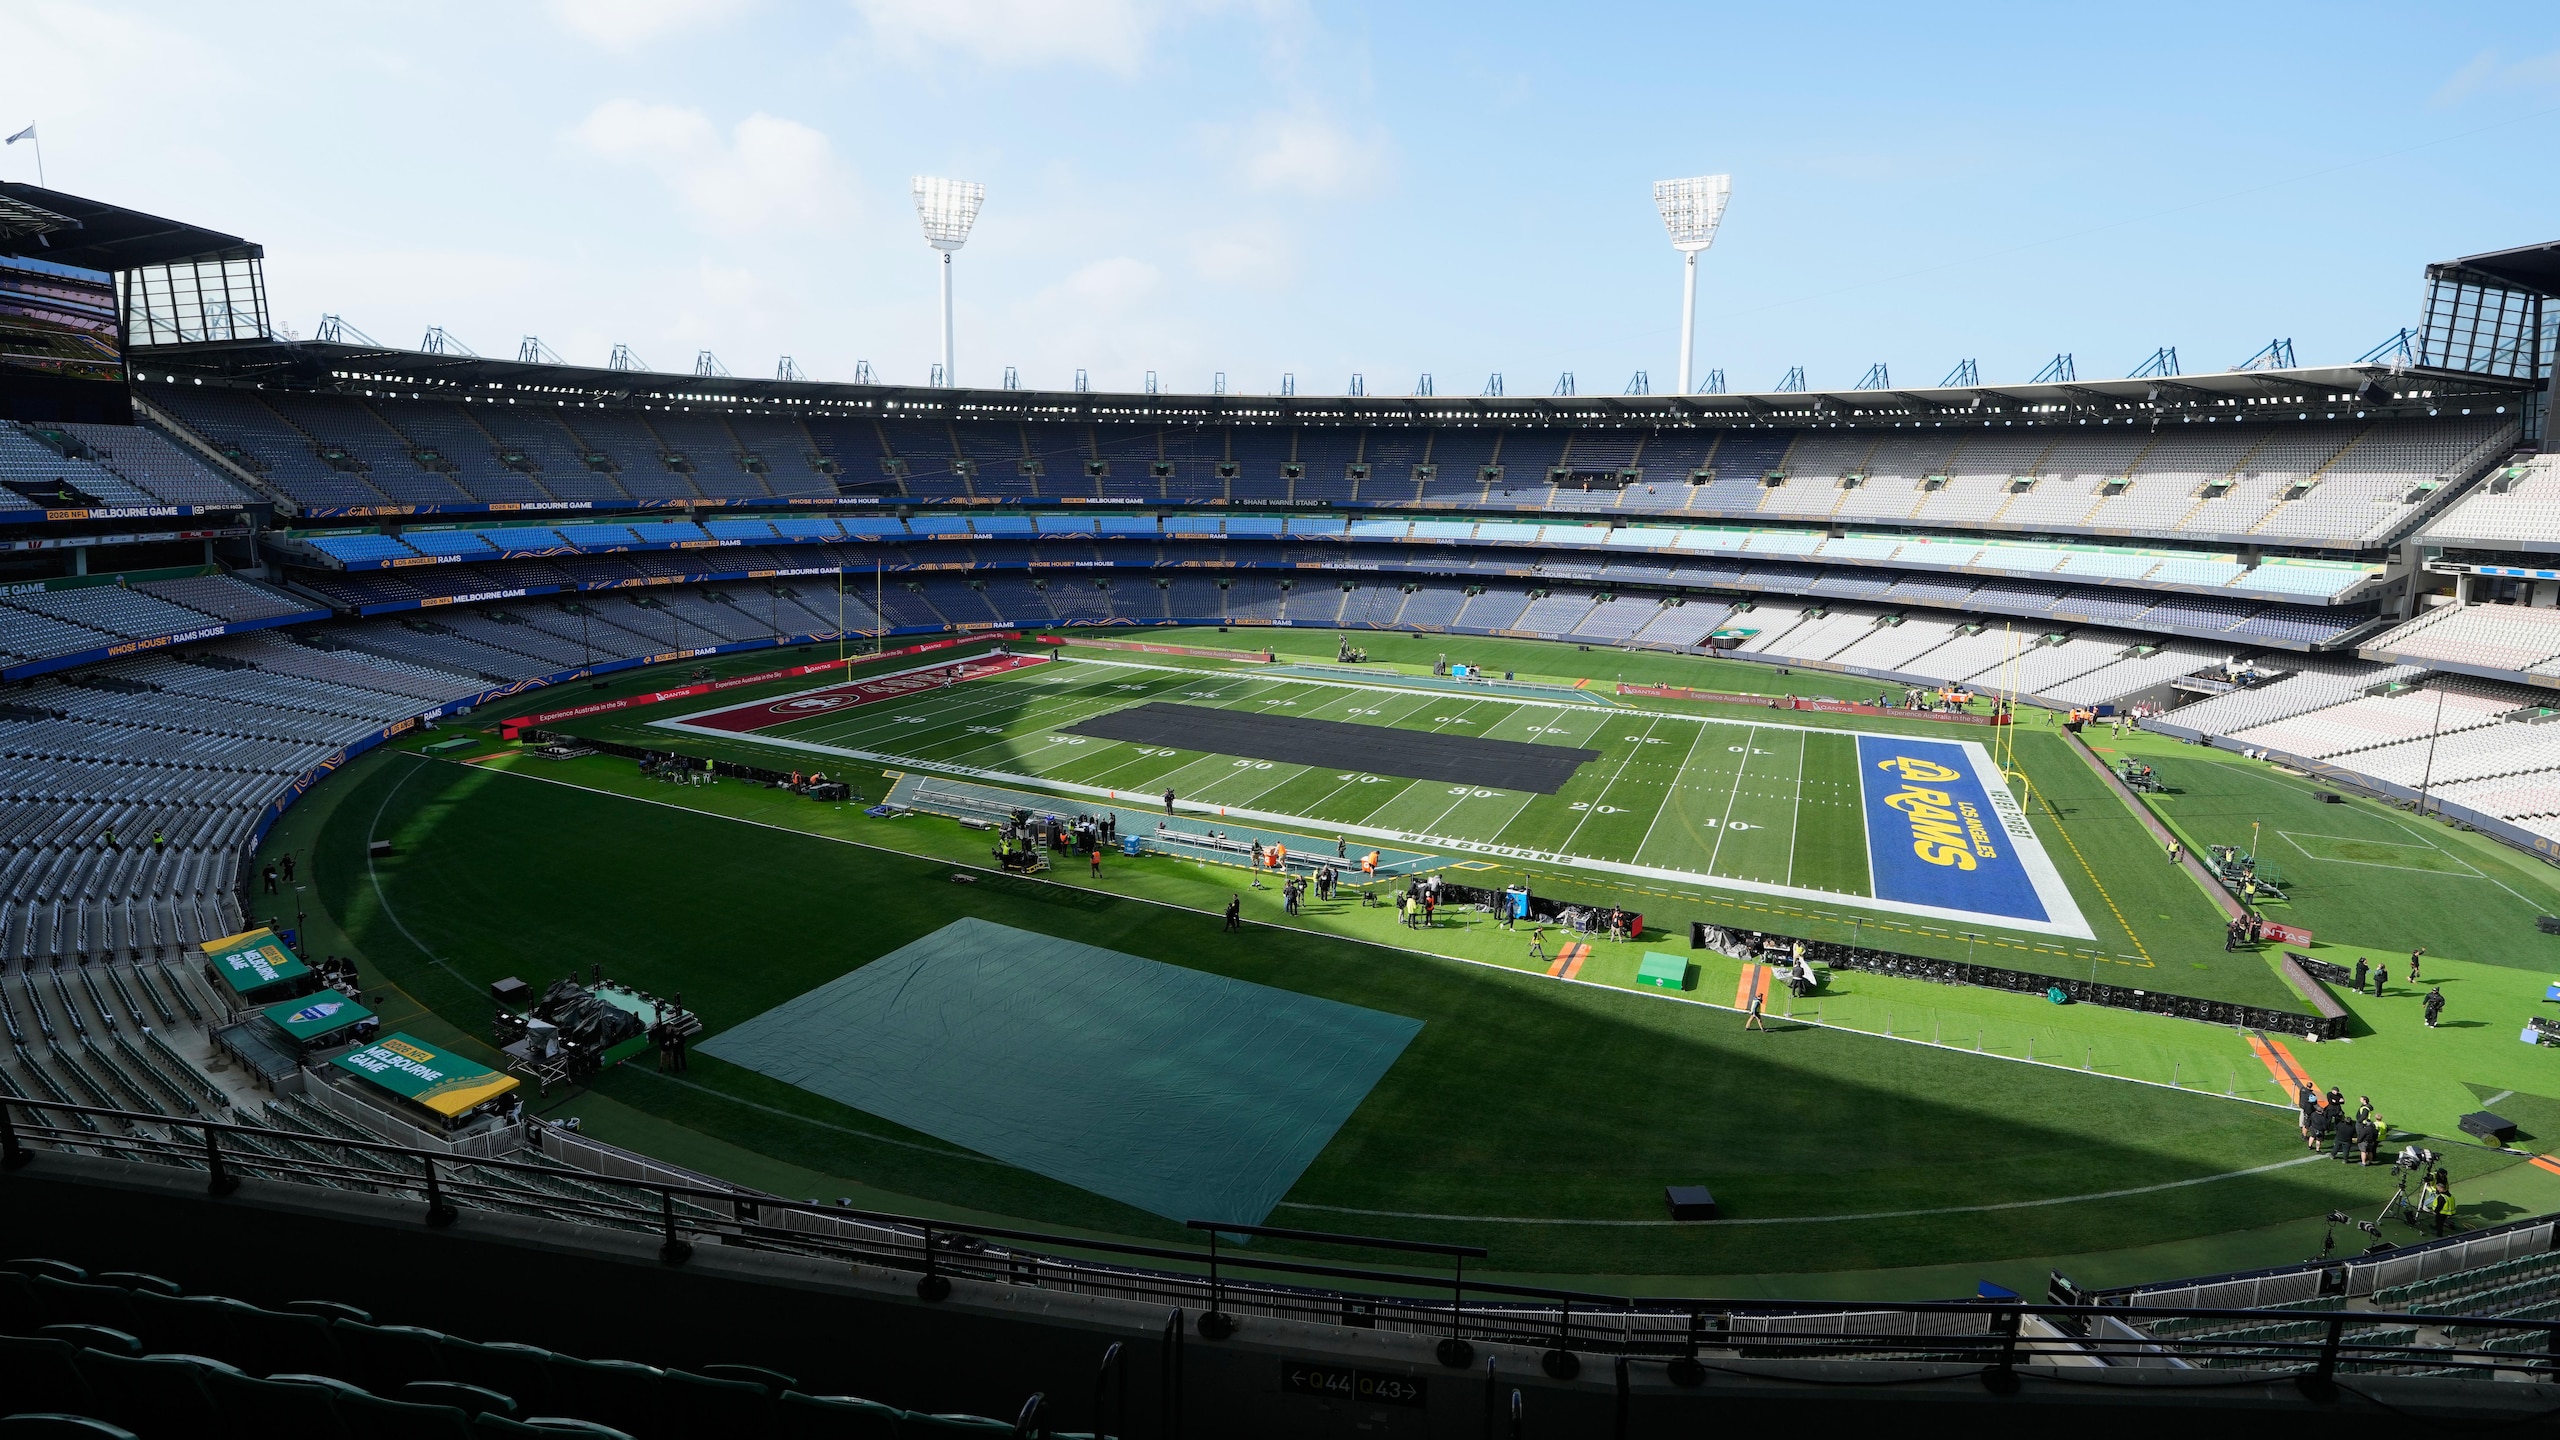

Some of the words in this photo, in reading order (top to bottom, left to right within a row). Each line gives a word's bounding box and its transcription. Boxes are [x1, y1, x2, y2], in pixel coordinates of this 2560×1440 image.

[944, 253, 951, 264] 3
[1687, 256, 1695, 266] 4
[520, 502, 568, 510] MELBOURNE
[569, 501, 593, 509] GAME
[49, 510, 70, 519] 2026
[71, 510, 87, 519] NFL
[89, 507, 148, 519] MELBOURNE
[149, 506, 179, 517] GAME
[2131, 530, 2189, 540] MELBOURNE
[2190, 532, 2219, 541] GAME
[692, 540, 718, 548] ANGELES
[719, 539, 742, 547] RAMS
[408, 557, 436, 565] ANGELES
[437, 554, 462, 564] RAMS
[776, 568, 820, 576] MELBOURNE
[2005, 570, 2031, 578] RAMS
[11, 582, 46, 596] GAME
[453, 590, 502, 604] MELBOURNE
[501, 588, 526, 598] GAME
[993, 621, 1015, 629] RAMS
[2088, 617, 2144, 630] MELBOURNE
[2145, 623, 2174, 633] GAME
[107, 641, 137, 657] WHOSE
[137, 635, 172, 648] HOUSE?
[173, 630, 198, 644] RAMS
[198, 625, 225, 639] HOUSE
[1537, 632, 1559, 640] RAMS
[694, 646, 717, 656] RAMS
[809, 663, 831, 672] QANTAS
[1844, 666, 1869, 675] RAMS
[715, 677, 742, 689] Experience
[741, 674, 761, 684] Australia
[773, 671, 783, 679] Sky
[2530, 676, 2556, 687] 2026
[663, 690, 690, 699] QANTAS
[1631, 688, 1661, 696] QANTAS
[1690, 692, 1723, 701] Experience
[1723, 694, 1749, 703] Australia
[1755, 696, 1767, 704] the
[424, 707, 442, 721] RAMS
[539, 710, 573, 723] Experience
[573, 706, 600, 716] Australia
[616, 700, 628, 709] Sky
[1348, 708, 1381, 716] 50
[1819, 705, 1853, 713] QANTAS
[1886, 709, 1922, 718] Experience
[1923, 711, 1952, 721] Australia
[1952, 713, 1959, 721] in
[1959, 713, 1971, 721] the
[1971, 714, 1985, 724] Sky
[1049, 736, 1086, 745] 30
[1138, 747, 1176, 757] 40
[1728, 746, 1764, 755] 10
[871, 753, 989, 776] MELBOURNE
[1233, 759, 1273, 770] 50
[1337, 773, 1379, 784] 40
[1448, 787, 1493, 799] 30
[1989, 789, 2016, 811] NEVER
[1568, 802, 1616, 814] 20
[1957, 801, 1979, 819] LOS
[1703, 818, 1749, 831] 10
[1884, 784, 1977, 871] RAMS
[2002, 812, 2033, 840] FORGET
[1966, 816, 1997, 859] ANGELES
[1398, 834, 1573, 864] MELBOURNE
[225, 954, 250, 971] GAME
[242, 949, 280, 982] MELBOURNE
[2286, 960, 2314, 994] Experience
[386, 1040, 411, 1054] 2026
[408, 1050, 430, 1062] NFL
[347, 1053, 391, 1074] GAME
[363, 1045, 444, 1082] MELBOURNE
[1309, 1371, 1351, 1392] Q44
[1359, 1377, 1401, 1398] Q43
